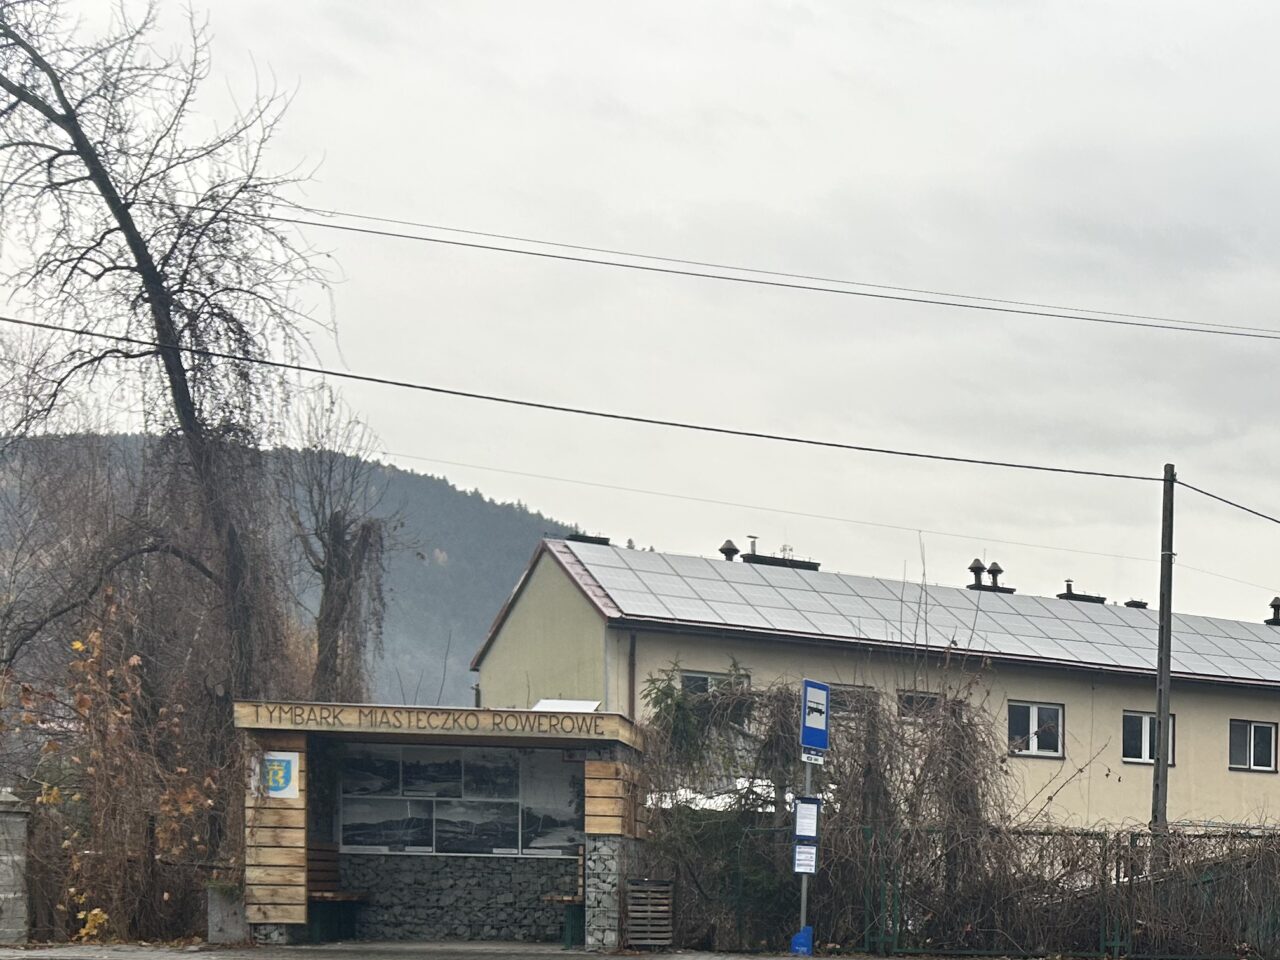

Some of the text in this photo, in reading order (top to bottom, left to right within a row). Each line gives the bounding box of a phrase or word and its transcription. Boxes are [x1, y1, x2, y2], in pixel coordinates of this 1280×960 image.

[251, 704, 605, 736] TYMBARK MIASTECZKO ROWEROWE
